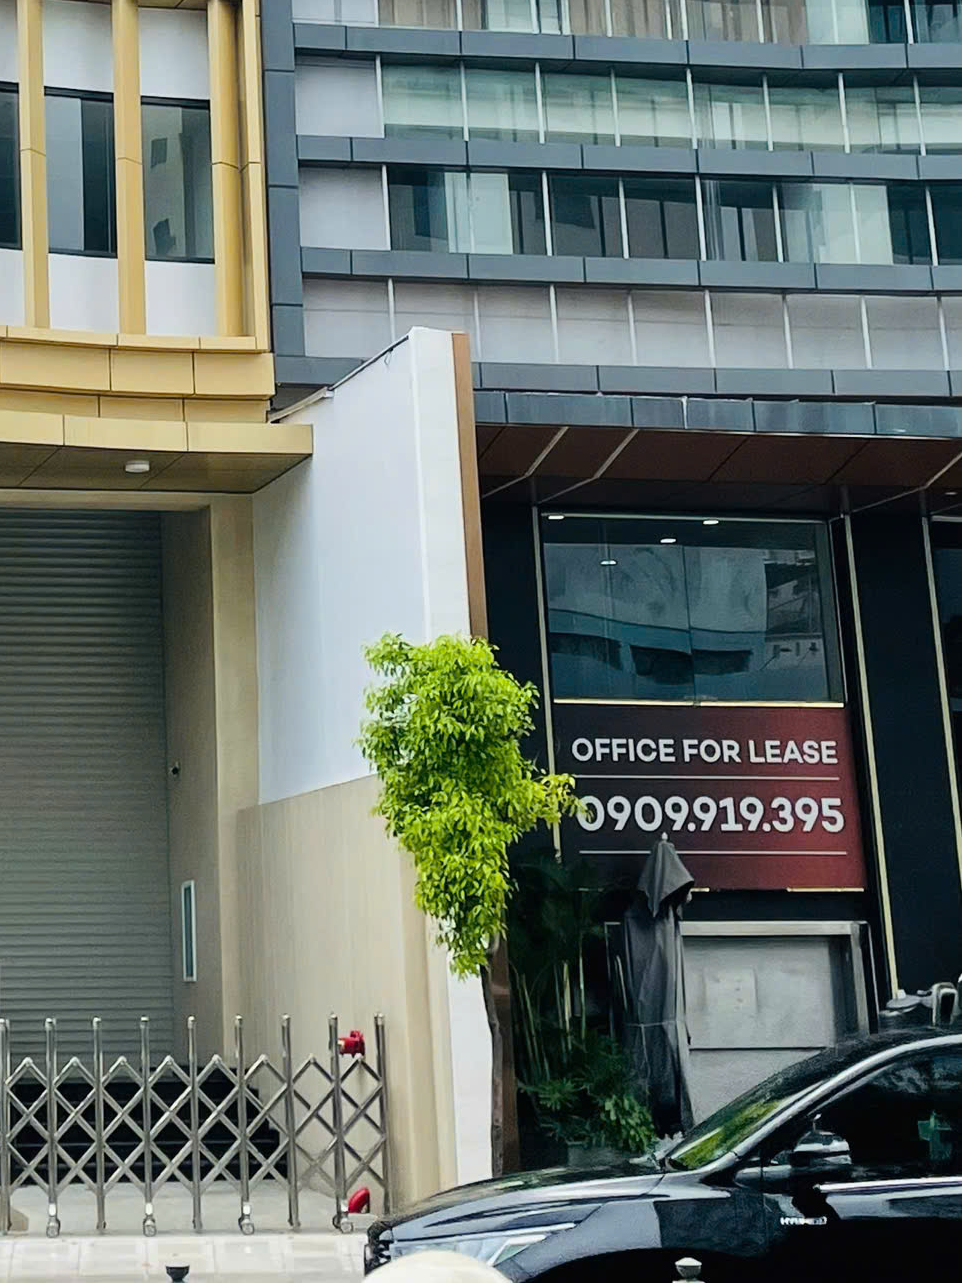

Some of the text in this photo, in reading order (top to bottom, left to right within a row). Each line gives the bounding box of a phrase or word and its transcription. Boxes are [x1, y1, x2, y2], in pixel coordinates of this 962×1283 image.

[572, 737, 838, 764] OFFICE FOR LEASE
[576, 795, 845, 833] 0909.919.395
